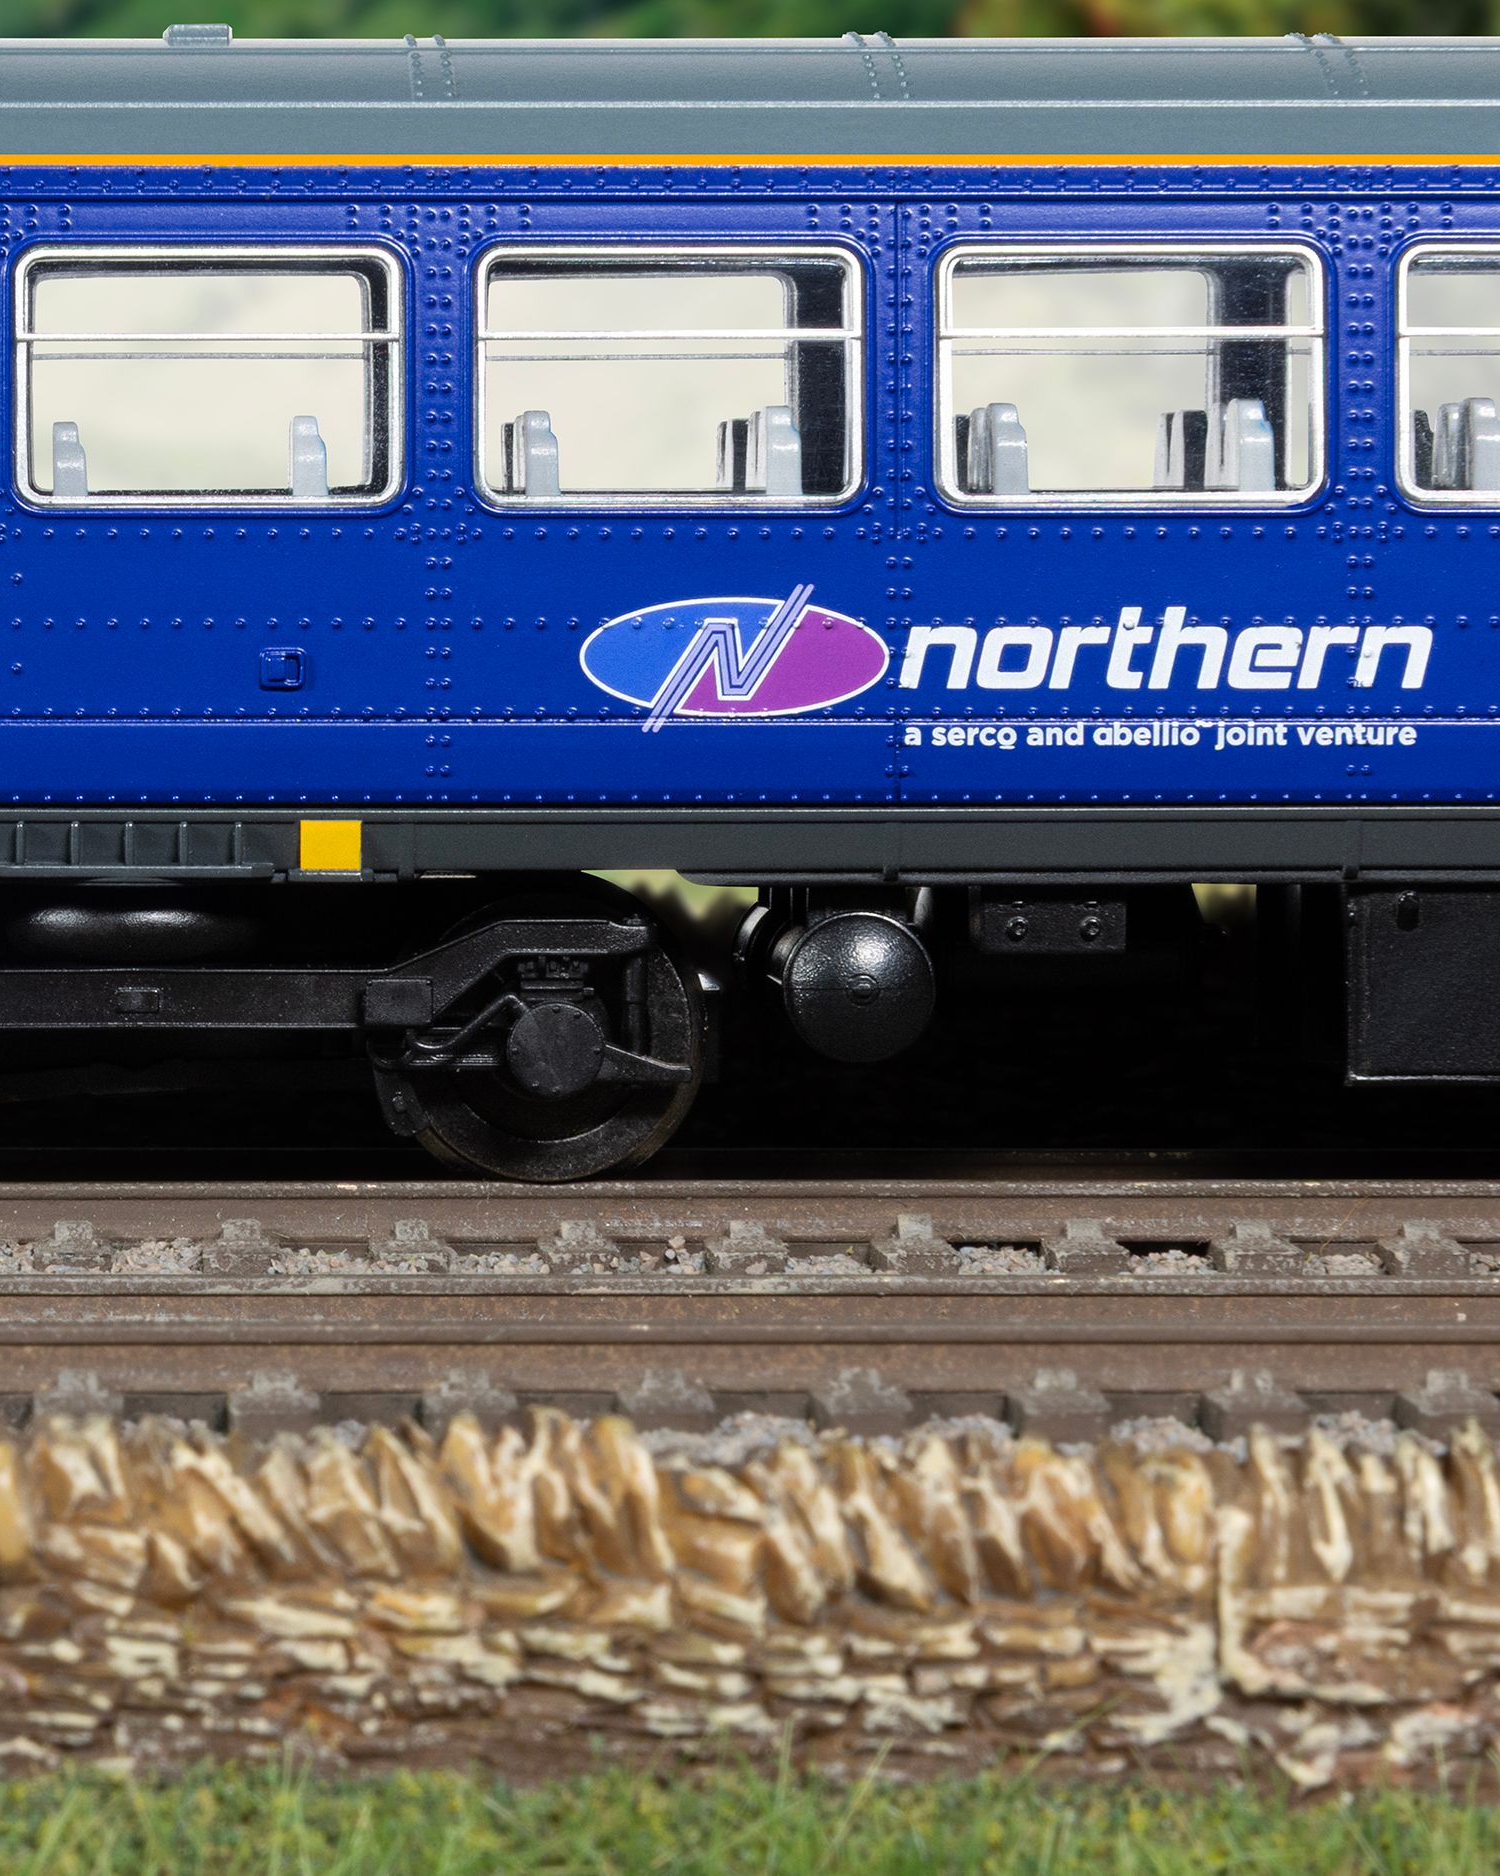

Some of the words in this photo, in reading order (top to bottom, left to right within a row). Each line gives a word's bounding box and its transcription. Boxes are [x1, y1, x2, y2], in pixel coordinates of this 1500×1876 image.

[898, 606, 1434, 690] northern
[904, 726, 922, 746] a
[931, 726, 1018, 750] serco
[1026, 721, 1084, 746] and
[1092, 721, 1201, 747] abellio
[1214, 721, 1288, 751] joint
[1296, 724, 1418, 747] venture
